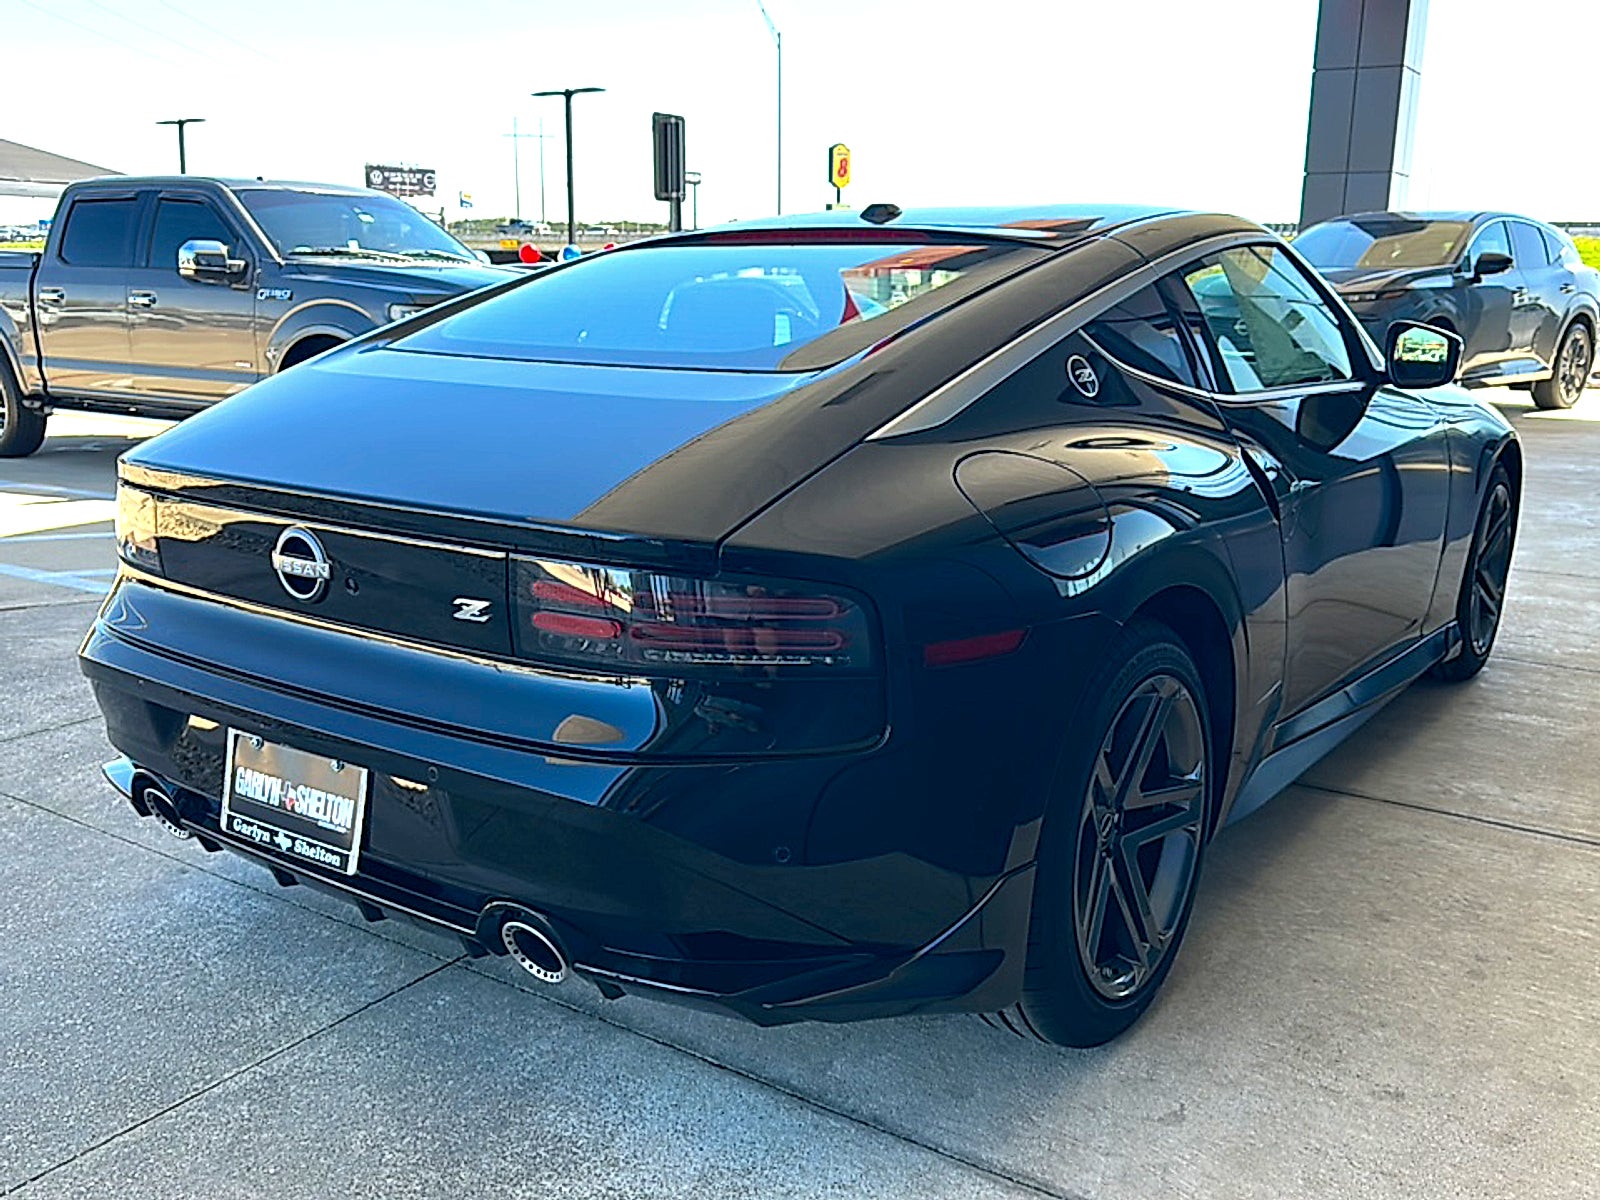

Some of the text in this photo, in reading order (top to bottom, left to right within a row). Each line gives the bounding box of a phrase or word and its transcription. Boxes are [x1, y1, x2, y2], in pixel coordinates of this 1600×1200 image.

[837, 157, 848, 178] 8
[273, 552, 330, 579] ISSAN
[453, 598, 492, 622] Z
[235, 766, 355, 829] GARLYN SHELTON
[233, 818, 341, 867] Garlyn Shelton
